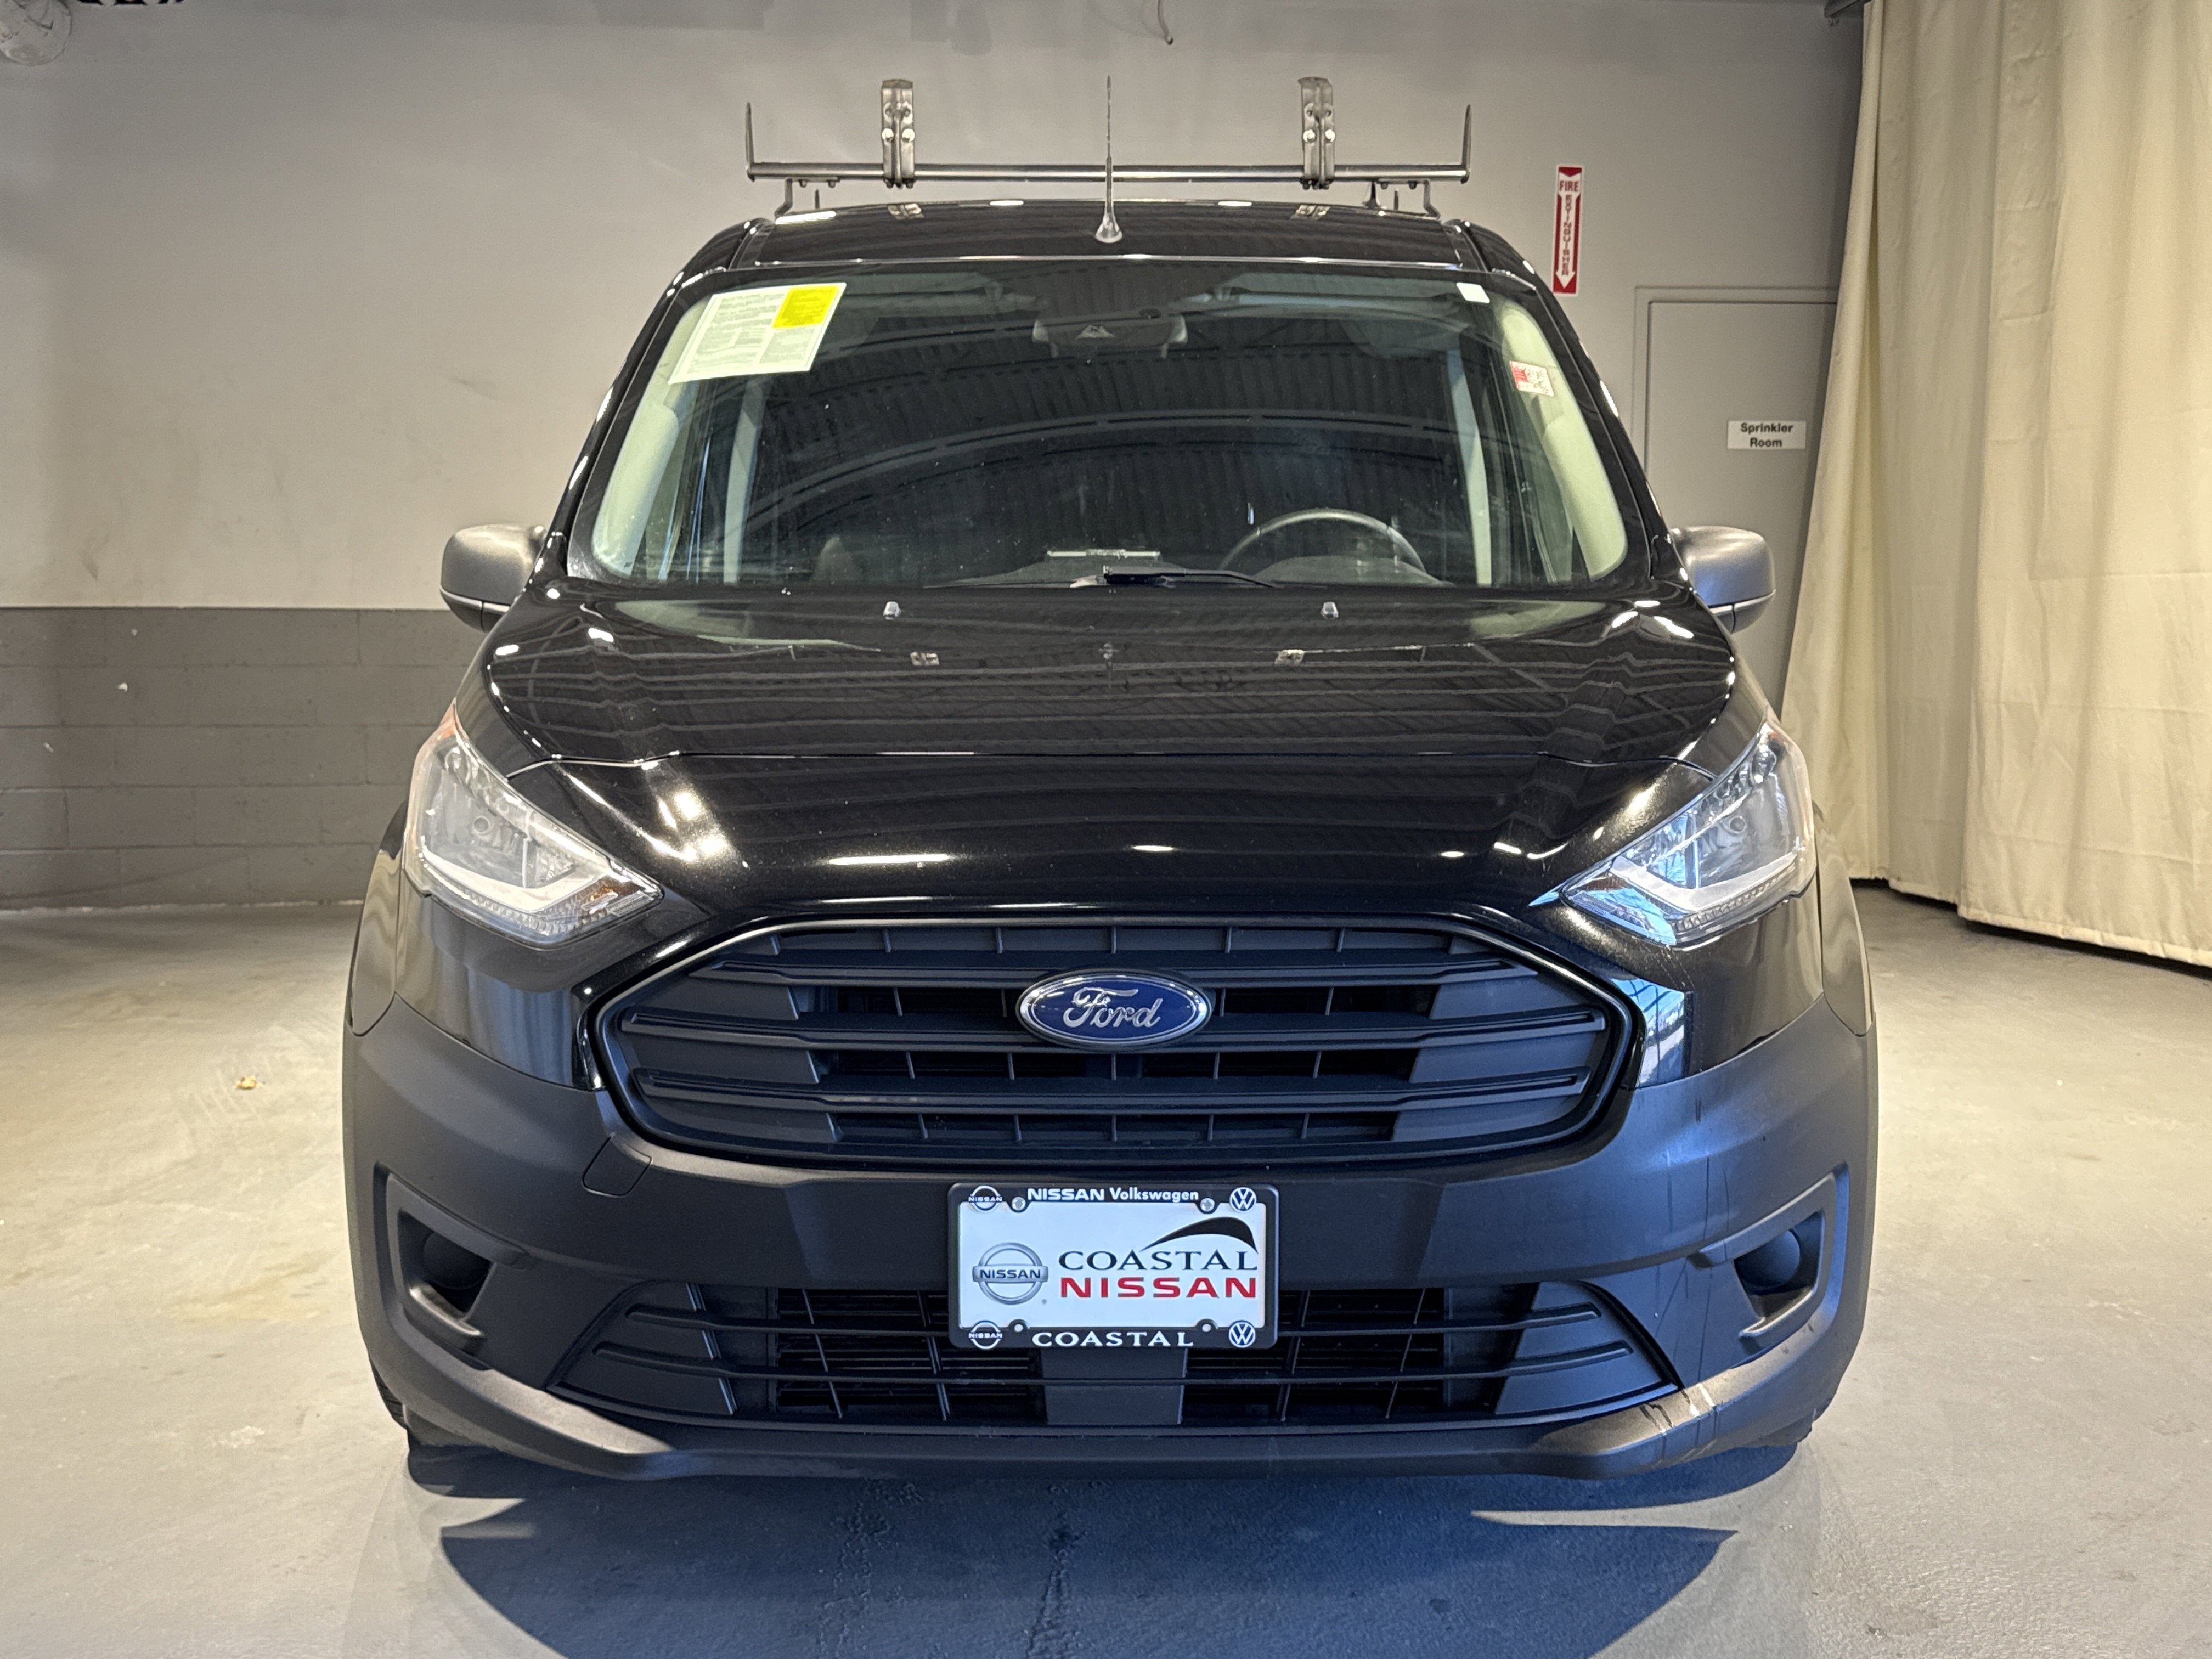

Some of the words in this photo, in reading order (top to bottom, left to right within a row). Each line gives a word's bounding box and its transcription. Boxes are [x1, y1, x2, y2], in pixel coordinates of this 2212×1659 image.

[1559, 180, 1579, 192] FIRE
[1561, 195, 1572, 275] EXTINGUISHER
[1740, 422, 1793, 434] Sprinkler
[1750, 437, 1782, 447] Room
[1062, 987, 1164, 1028] Ford
[1028, 1188, 1105, 1201] NISSAN
[1109, 1187, 1199, 1203] Volkswagen
[1058, 1249, 1258, 1271] COASTAL
[979, 1268, 1041, 1279] NISSAN
[1060, 1277, 1256, 1299] NISSAN
[1032, 1331, 1193, 1347] COASTAL
